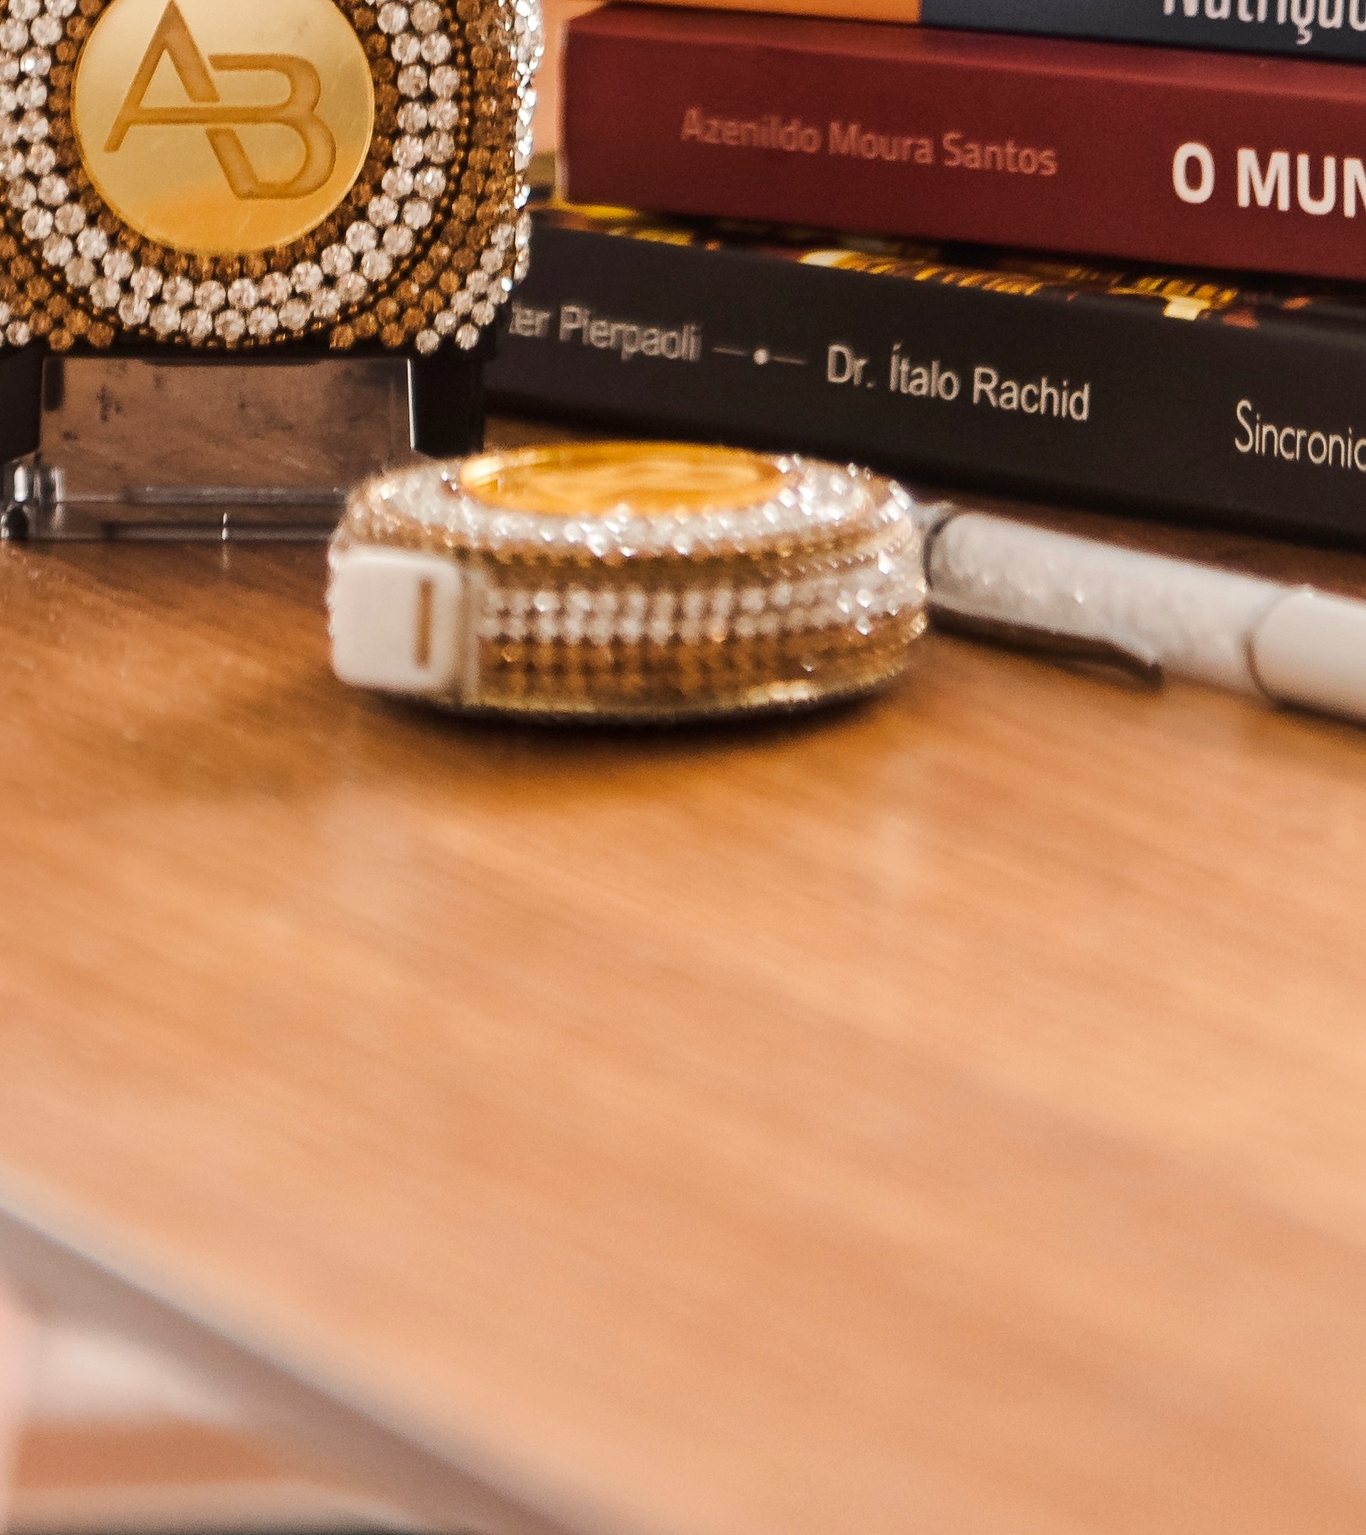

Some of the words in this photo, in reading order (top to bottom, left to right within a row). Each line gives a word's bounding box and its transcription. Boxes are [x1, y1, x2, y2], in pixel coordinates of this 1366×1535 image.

[103, 0, 335, 200] AB
[680, 106, 822, 155] Azenildo
[829, 120, 933, 165] Moura
[942, 129, 1058, 177] Santos
[1172, 141, 1216, 205] O
[559, 303, 702, 362] Pierpaoli
[827, 343, 874, 389] Dr.
[889, 342, 959, 401] Ítalo
[972, 366, 1090, 422] Rachid
